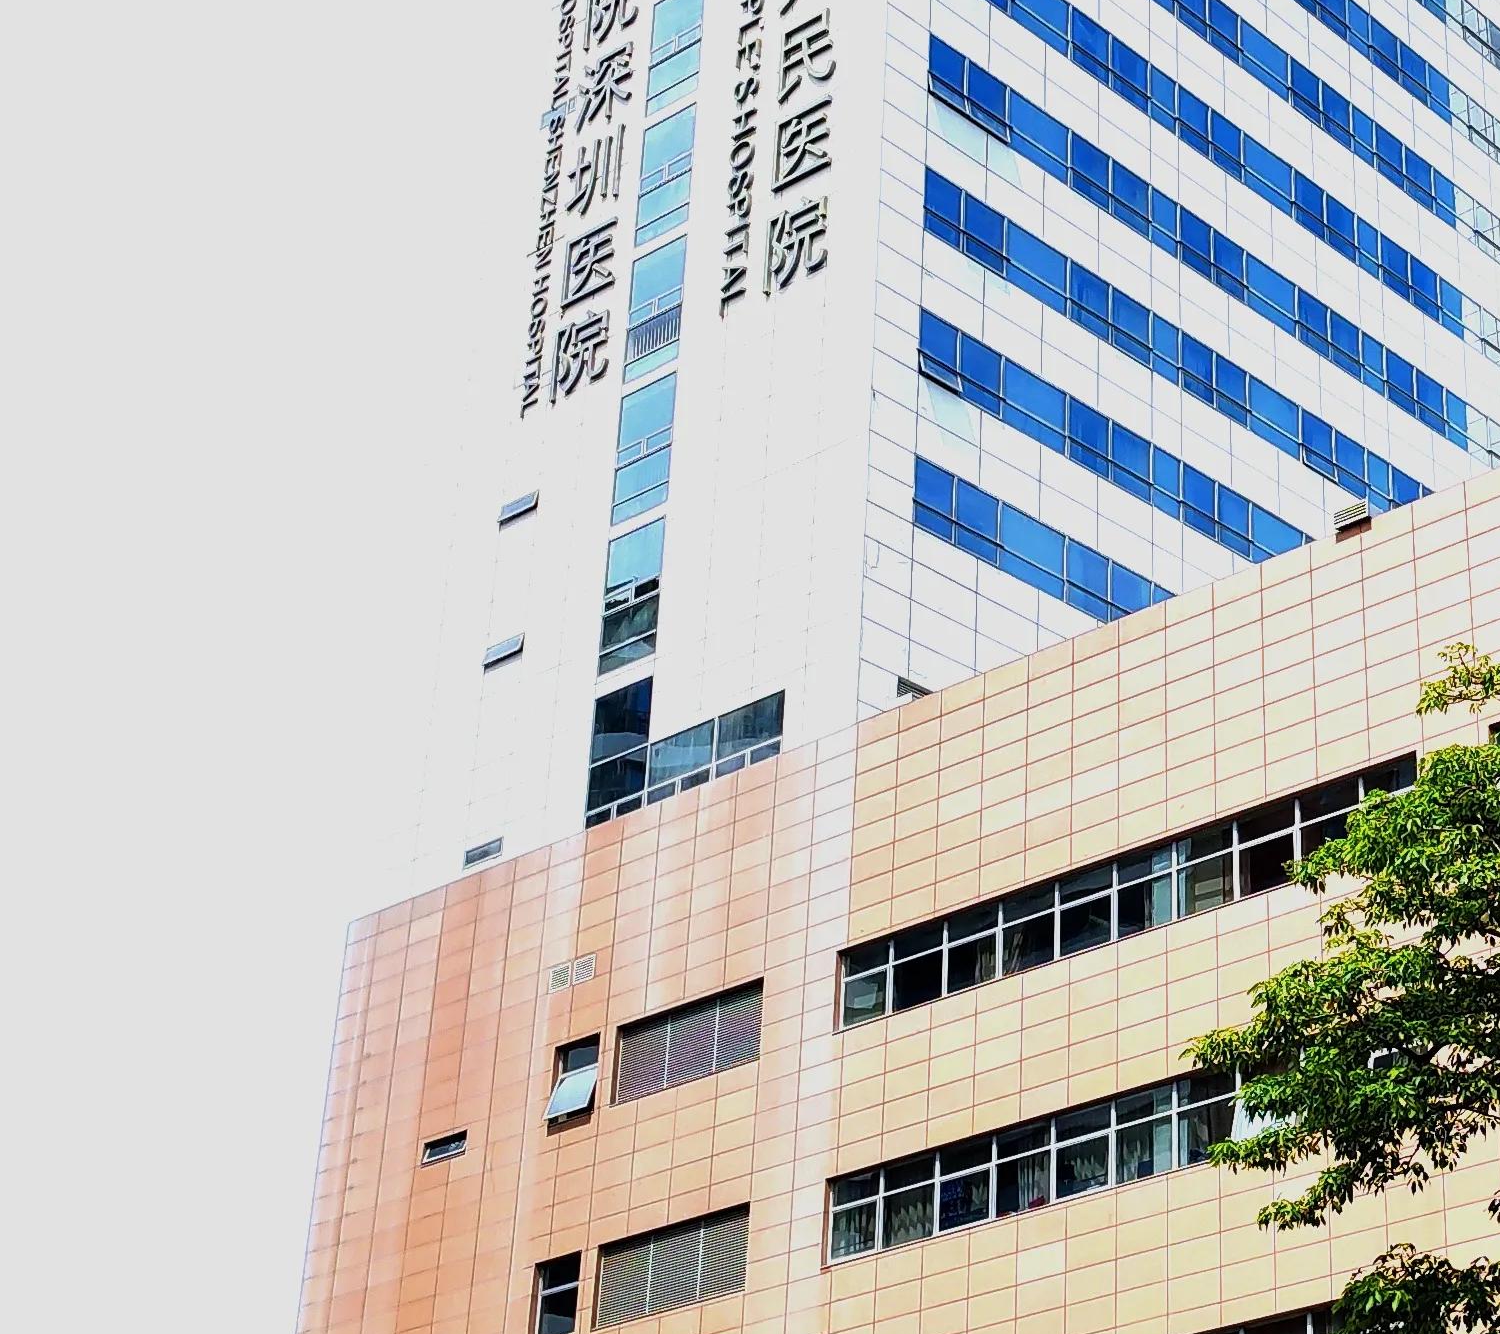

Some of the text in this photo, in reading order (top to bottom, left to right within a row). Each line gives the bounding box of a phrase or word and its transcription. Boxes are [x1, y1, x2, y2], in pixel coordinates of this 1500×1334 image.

[535, 114, 566, 271] SHENZHEN
[719, 107, 758, 321] HOSPITAL
[520, 273, 550, 419] HOSPITAL
